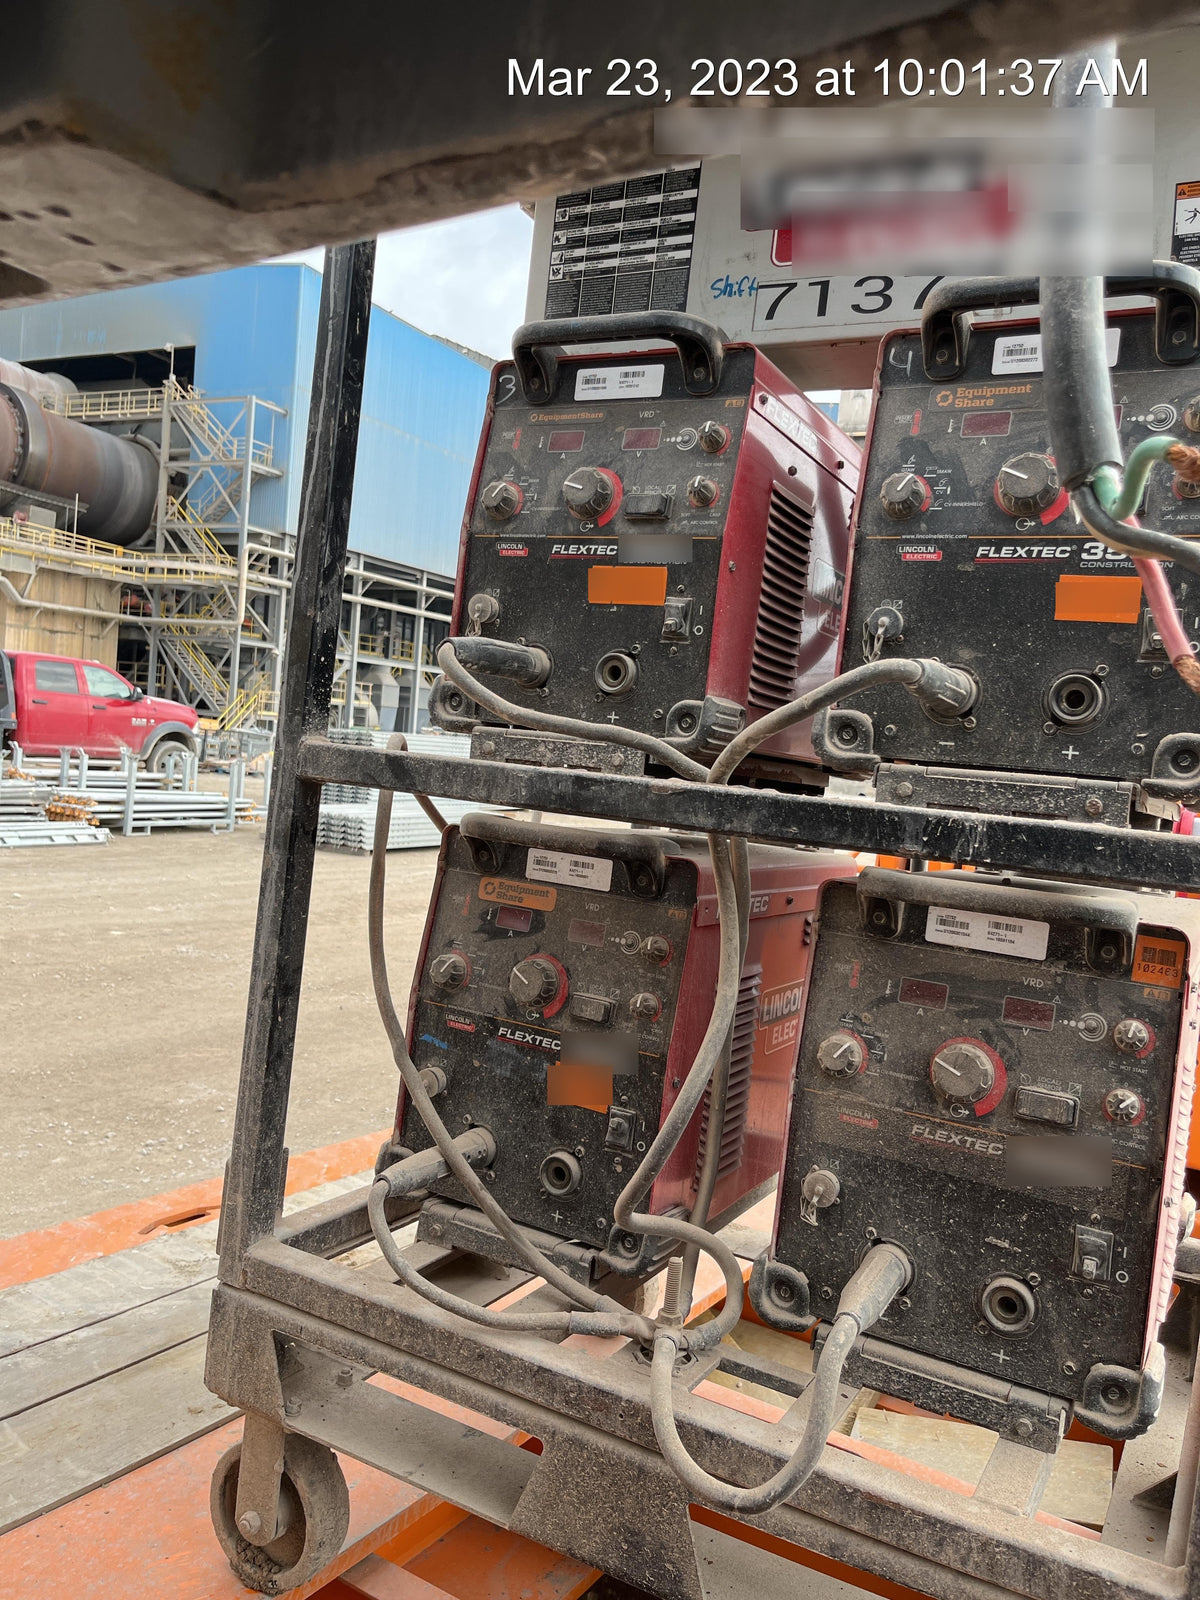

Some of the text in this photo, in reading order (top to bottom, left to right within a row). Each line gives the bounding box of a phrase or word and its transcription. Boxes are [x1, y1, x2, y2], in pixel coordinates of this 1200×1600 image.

[710, 274, 759, 299] Shift
[758, 275, 946, 321] 7137
[888, 347, 913, 378] 4
[496, 374, 516, 405] 3
[956, 384, 1032, 398] Equipment
[954, 398, 994, 408] Share
[538, 411, 604, 422] EquipmentShare
[639, 410, 655, 419] VRD
[765, 399, 818, 451] FLEXTEC
[551, 544, 618, 556] FLEXTEC
[495, 890, 523, 904] Share
[498, 881, 549, 898] Equipment
[585, 902, 600, 912] VRD
[1023, 976, 1044, 988] VRD
[761, 986, 802, 1022] LINCO
[499, 1027, 561, 1050] FLEXTEC
[771, 1018, 798, 1045] ELEC
[836, 1105, 871, 1120] LINCOLN
[911, 1125, 1004, 1155] FLEXTEC
